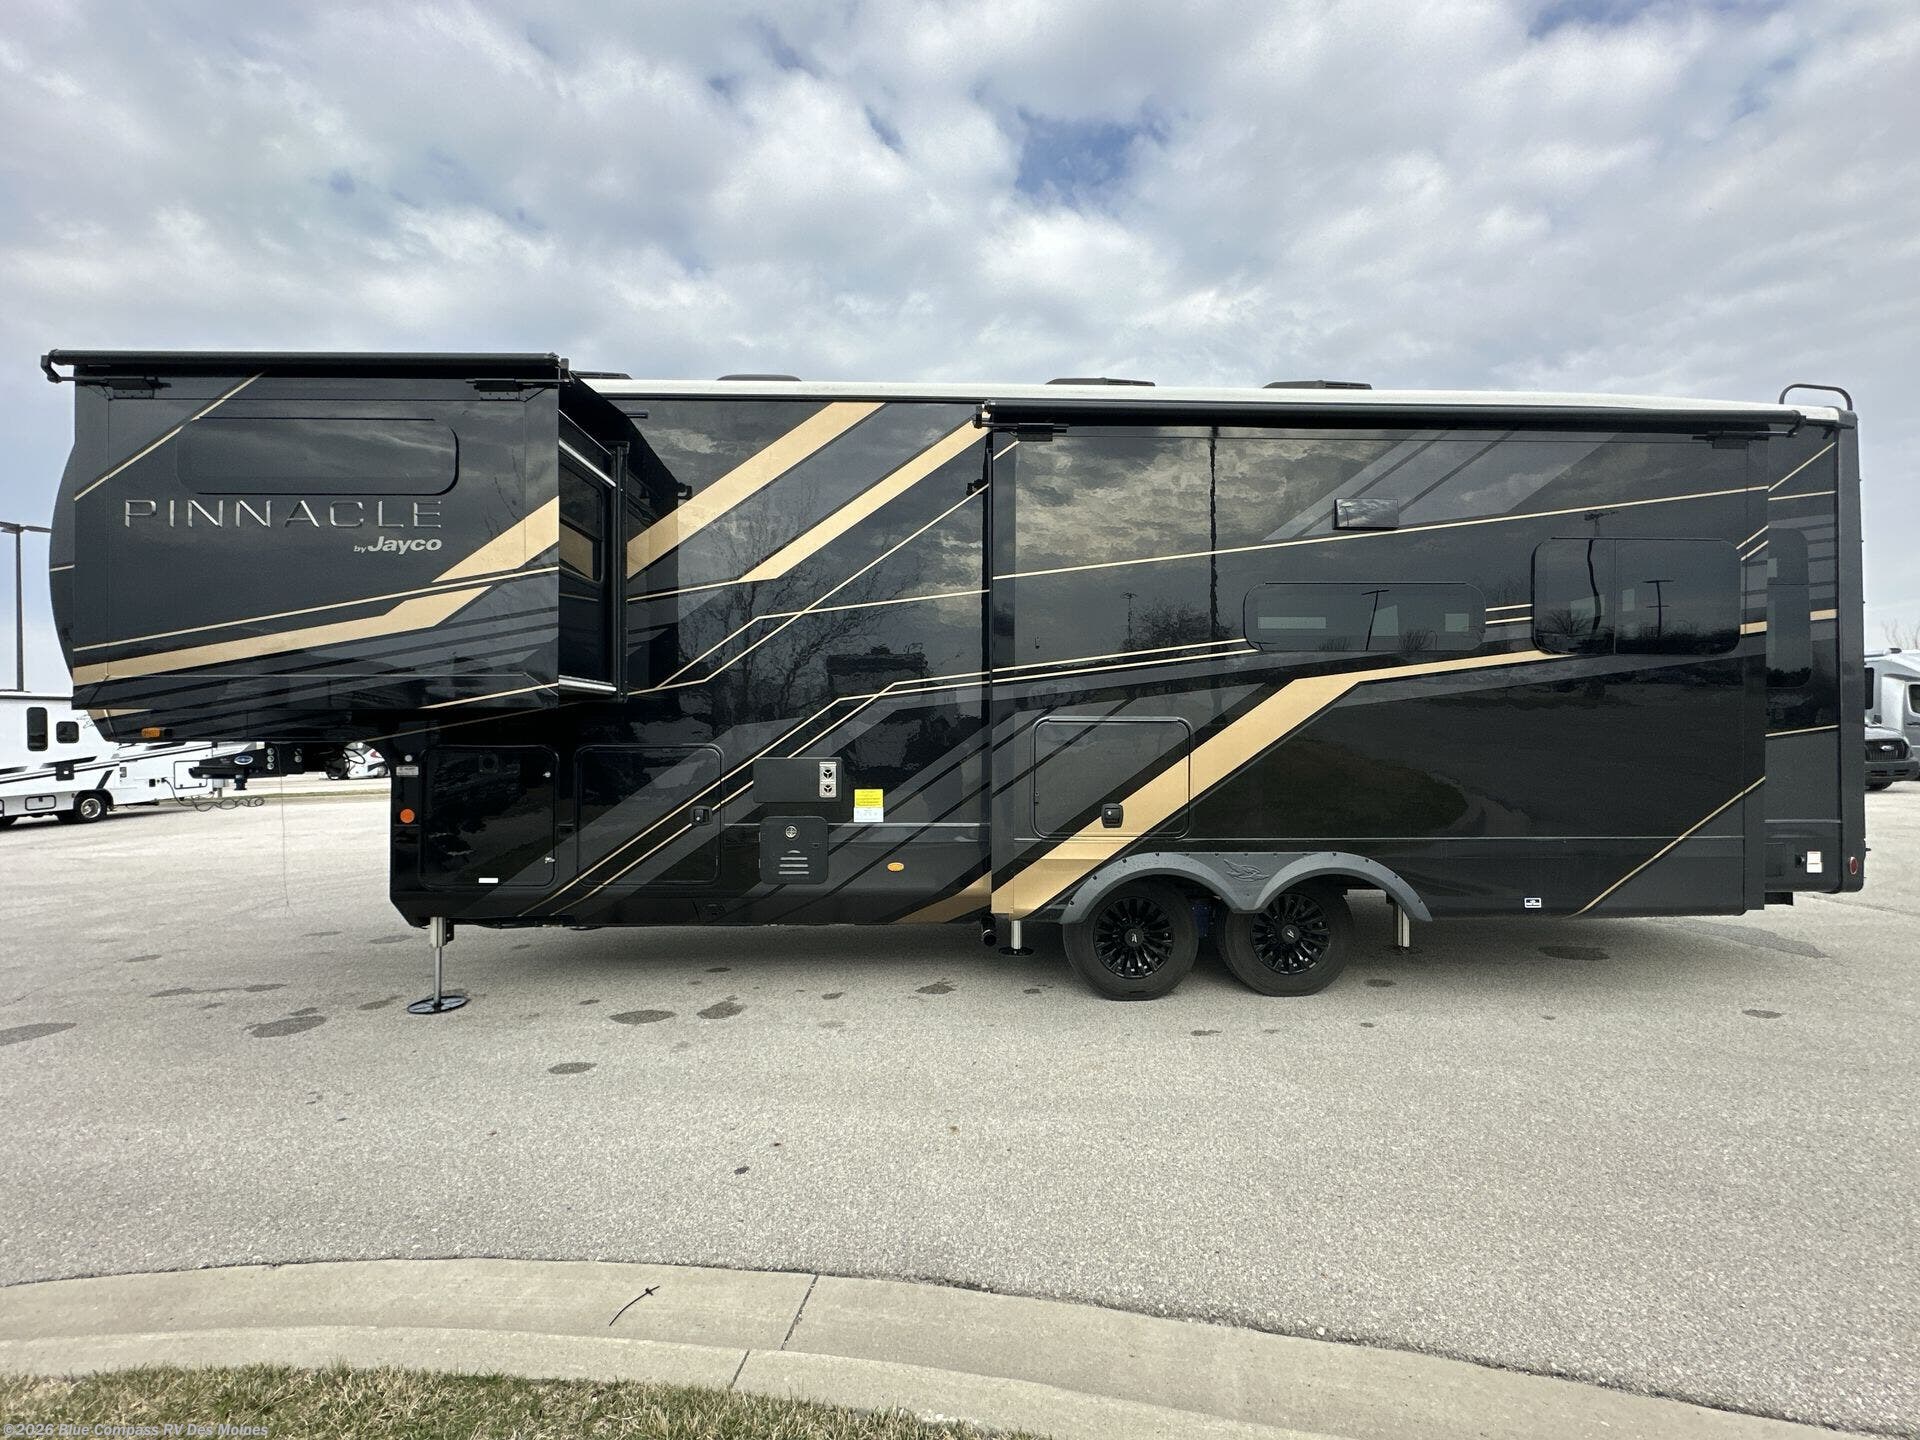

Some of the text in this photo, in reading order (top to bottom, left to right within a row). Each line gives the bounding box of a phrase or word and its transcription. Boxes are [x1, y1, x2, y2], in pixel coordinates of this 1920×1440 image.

[124, 500, 442, 528] PINNACLE
[353, 536, 442, 555] by Jayco
